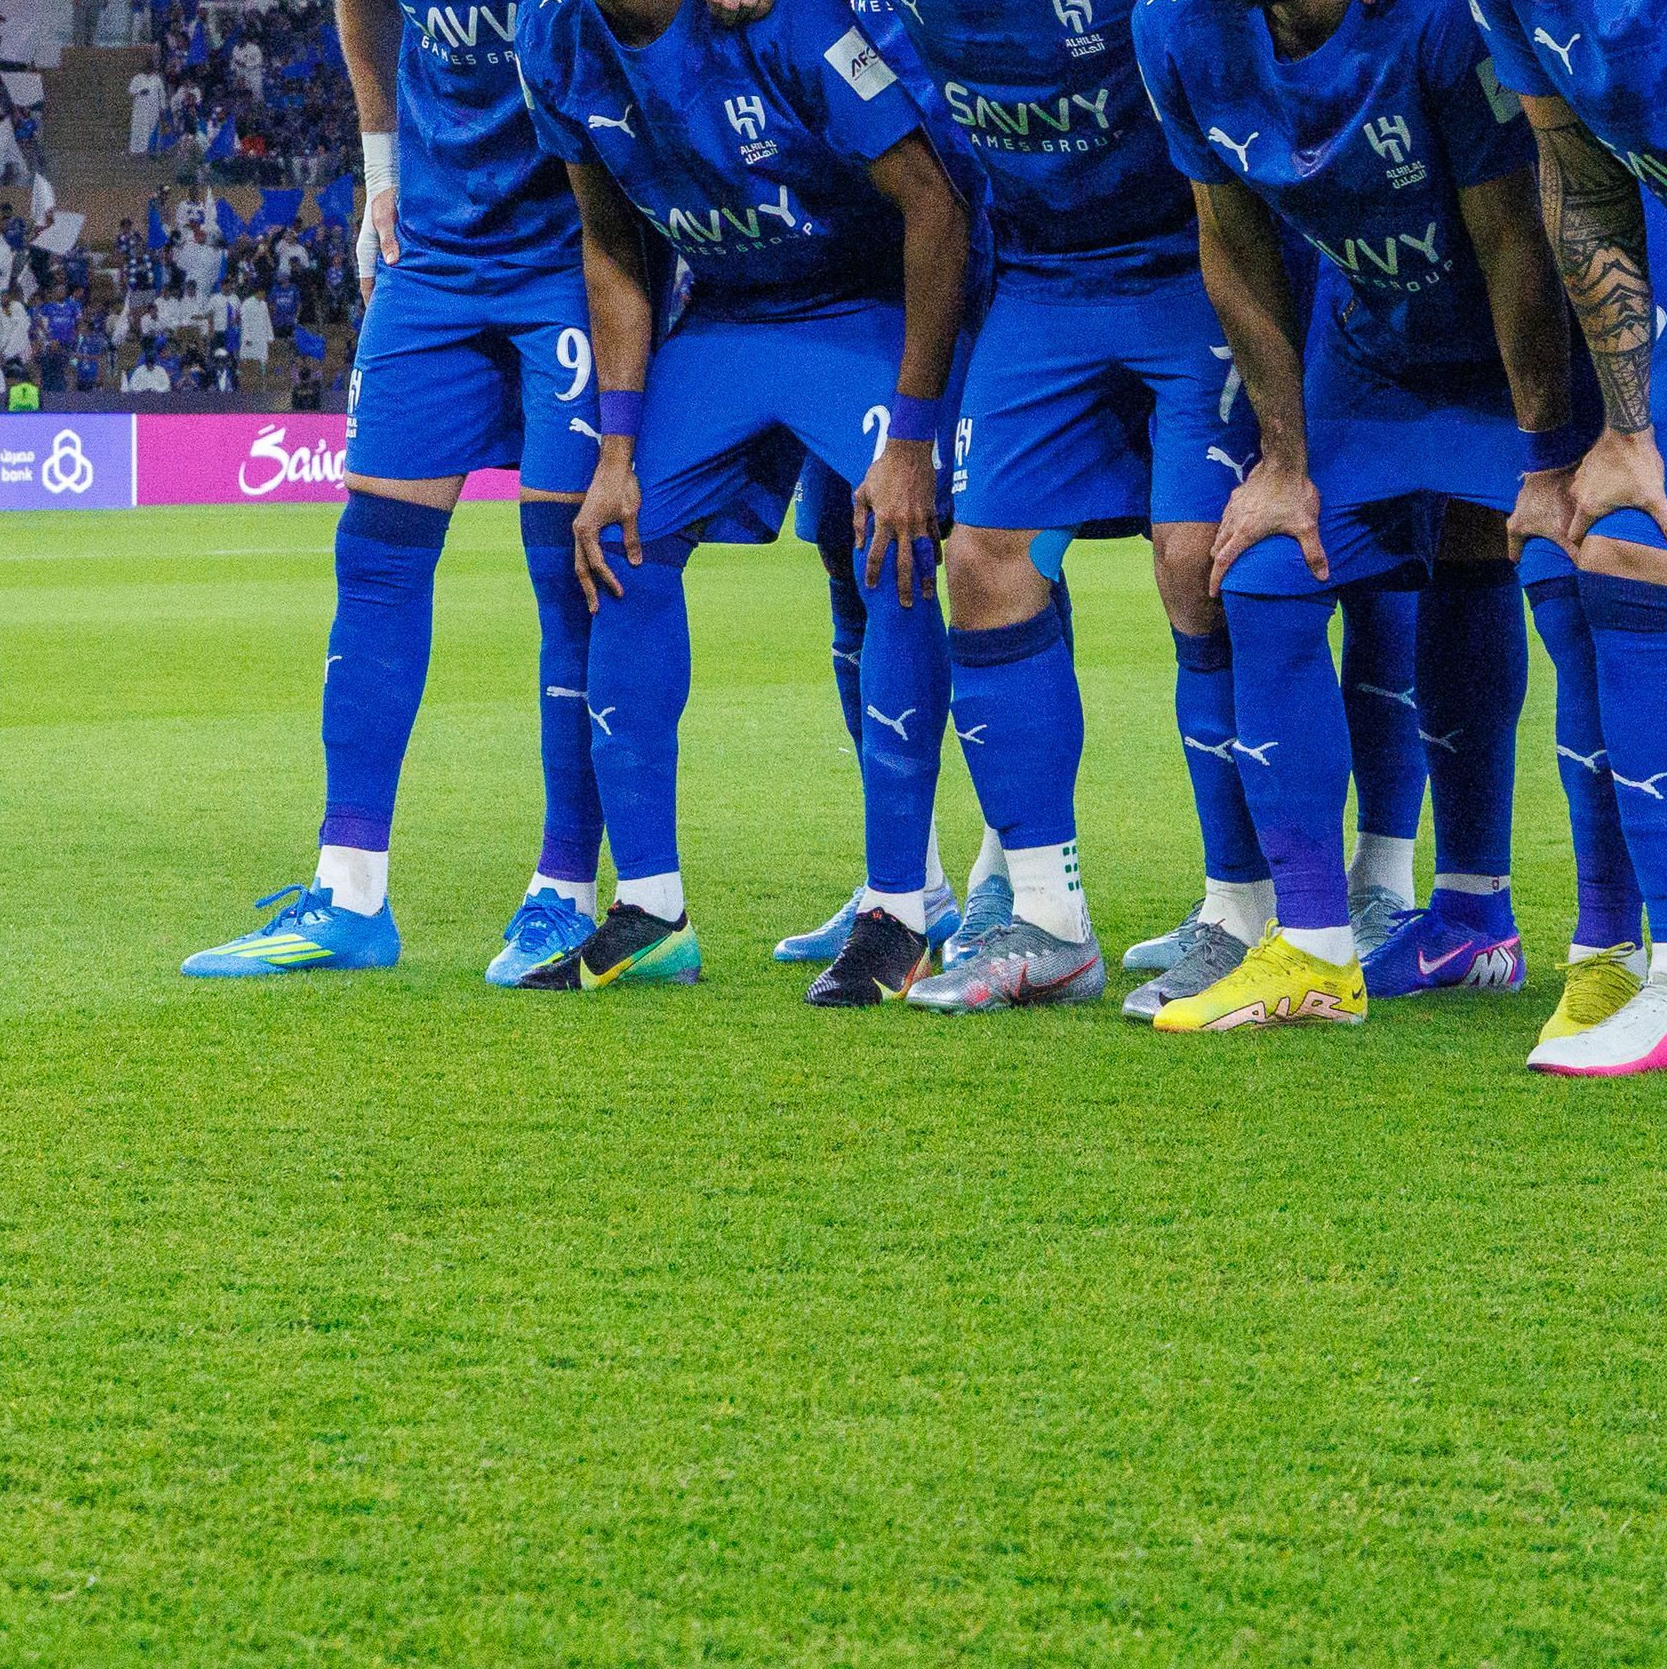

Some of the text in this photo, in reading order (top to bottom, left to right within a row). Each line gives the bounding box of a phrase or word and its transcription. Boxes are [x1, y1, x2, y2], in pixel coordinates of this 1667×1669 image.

[944, 80, 1110, 136] SAVVY
[554, 327, 593, 402] 9
[1, 465, 33, 483] bank
